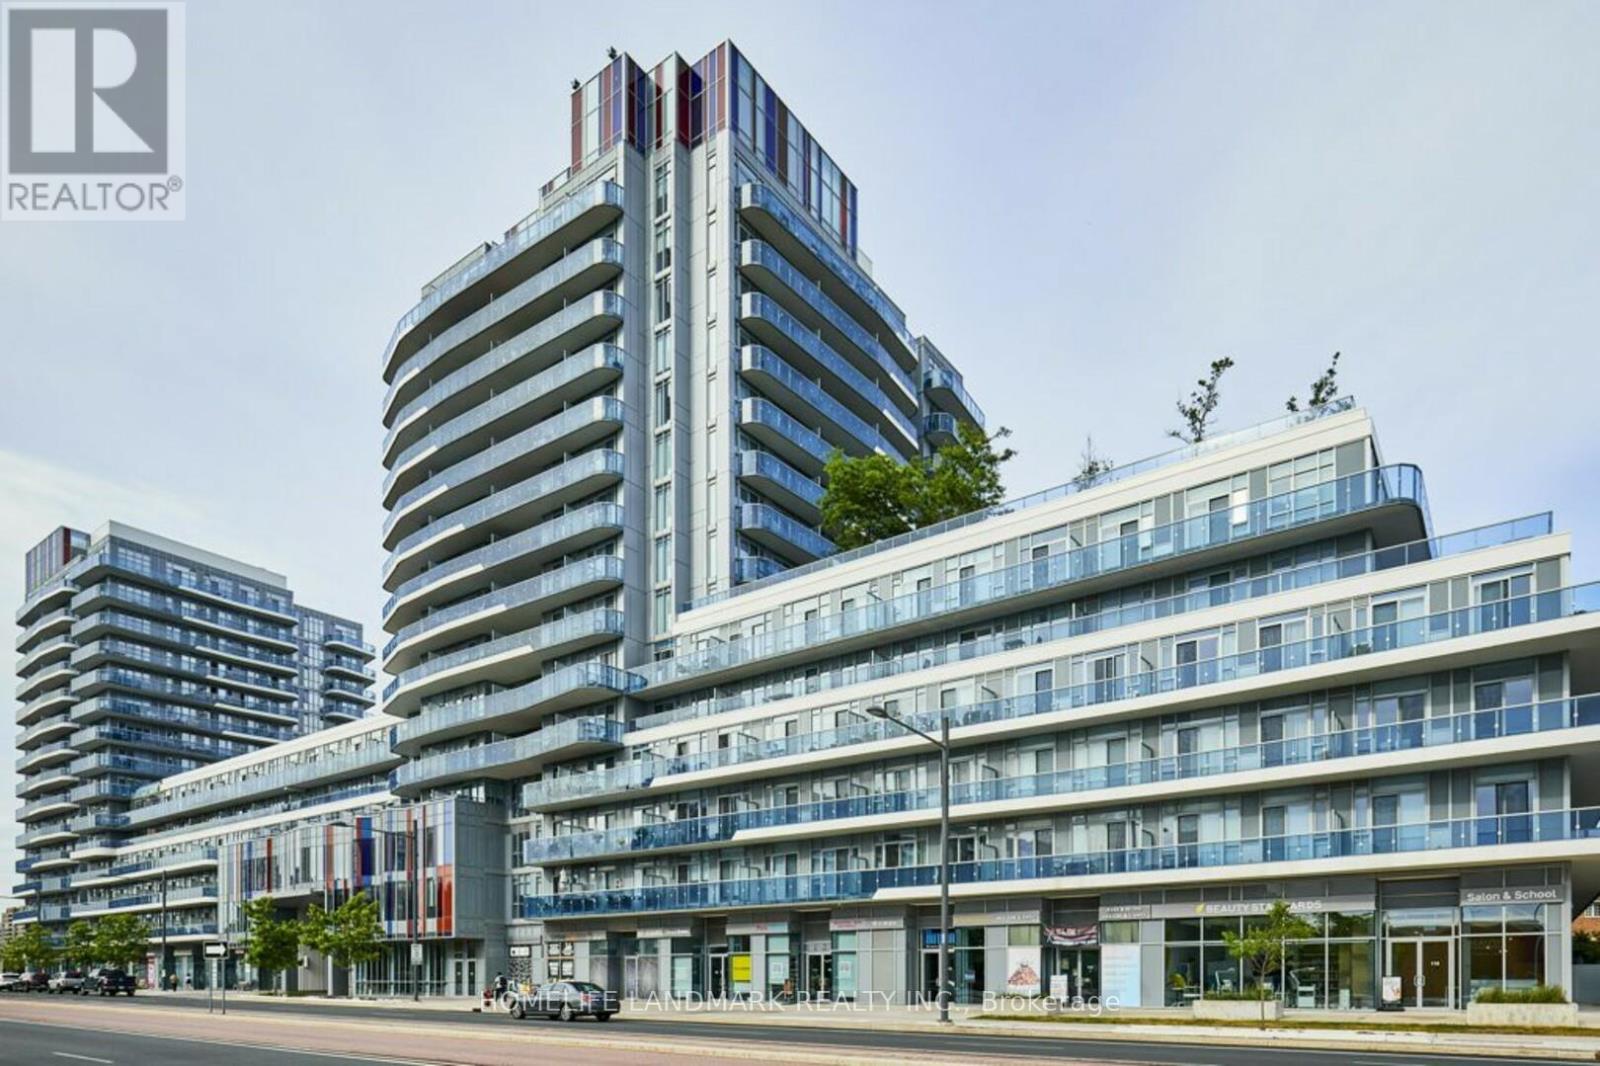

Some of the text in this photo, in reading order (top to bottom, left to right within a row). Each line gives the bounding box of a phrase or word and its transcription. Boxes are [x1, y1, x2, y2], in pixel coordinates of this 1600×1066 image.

[1467, 889, 1557, 902] Salon & School
[1206, 901, 1322, 914] BEAUTY STAARDS
